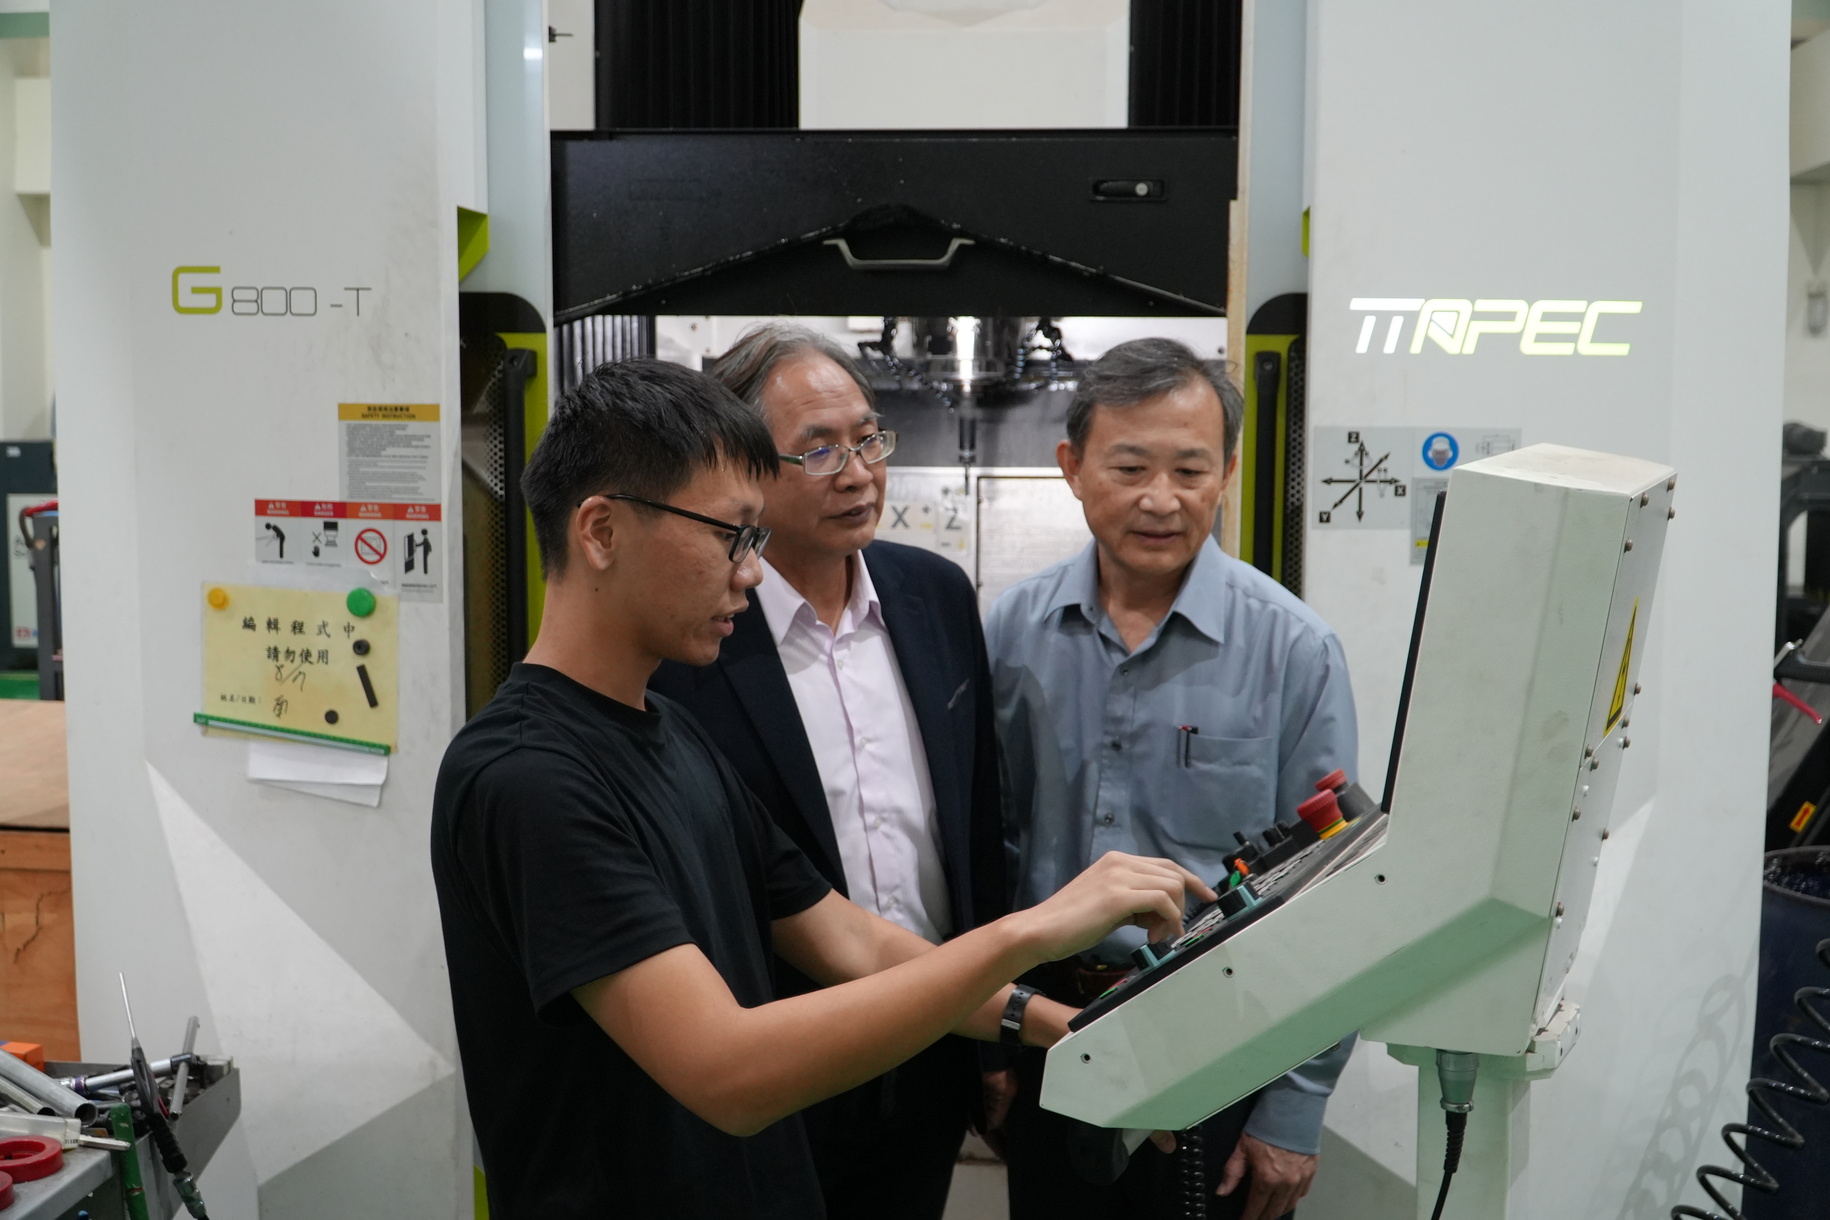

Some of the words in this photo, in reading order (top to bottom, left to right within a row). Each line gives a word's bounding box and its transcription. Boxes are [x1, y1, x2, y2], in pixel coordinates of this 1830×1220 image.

[891, 505, 909, 529] X
[242, 616, 355, 639] 編輯程式中
[265, 645, 329, 665] 請勿使用
